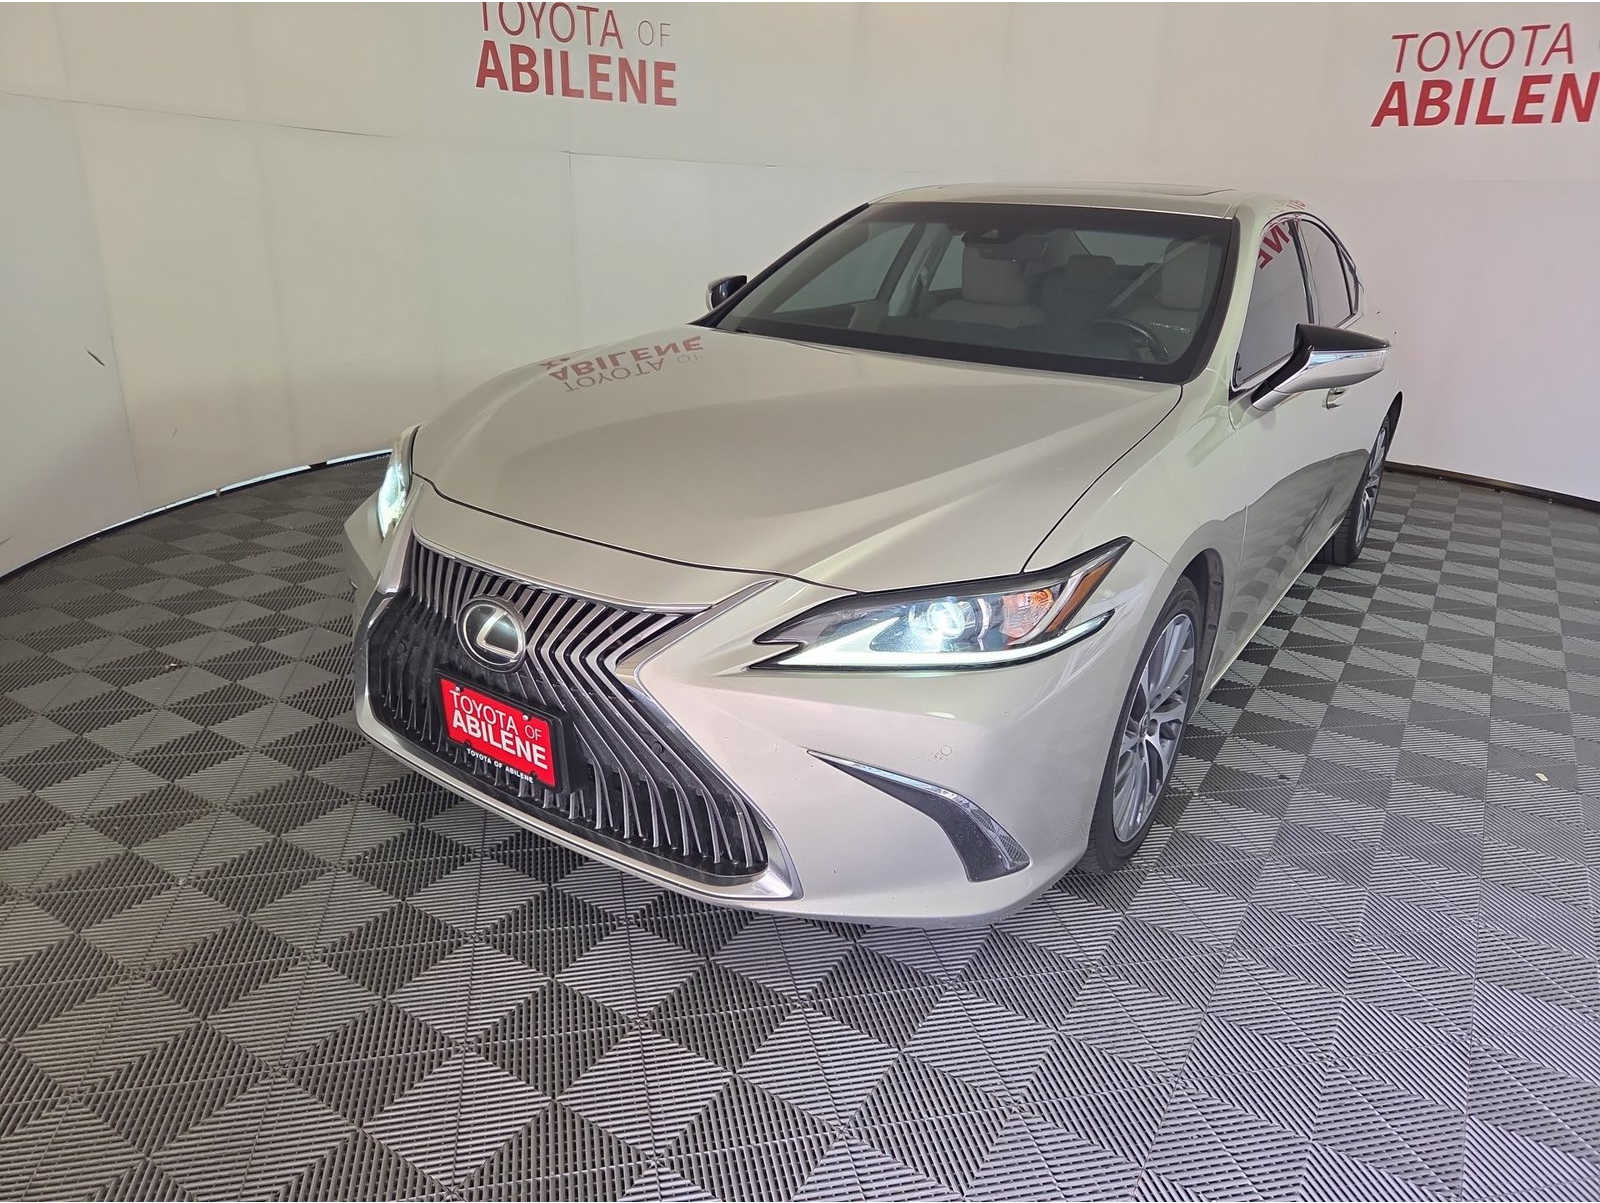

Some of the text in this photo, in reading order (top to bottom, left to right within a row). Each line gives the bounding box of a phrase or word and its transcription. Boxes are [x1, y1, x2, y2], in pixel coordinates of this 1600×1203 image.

[481, 2, 671, 49] TOYOTA OF
[1392, 23, 1573, 73] TOYOTA
[475, 39, 677, 106] ABILENE
[1370, 71, 1600, 127] ABILEN
[449, 689, 542, 740] TOYOTA OF
[452, 709, 548, 770] ABILENE
[466, 747, 534, 784] TOYOTA OF ABILENE
